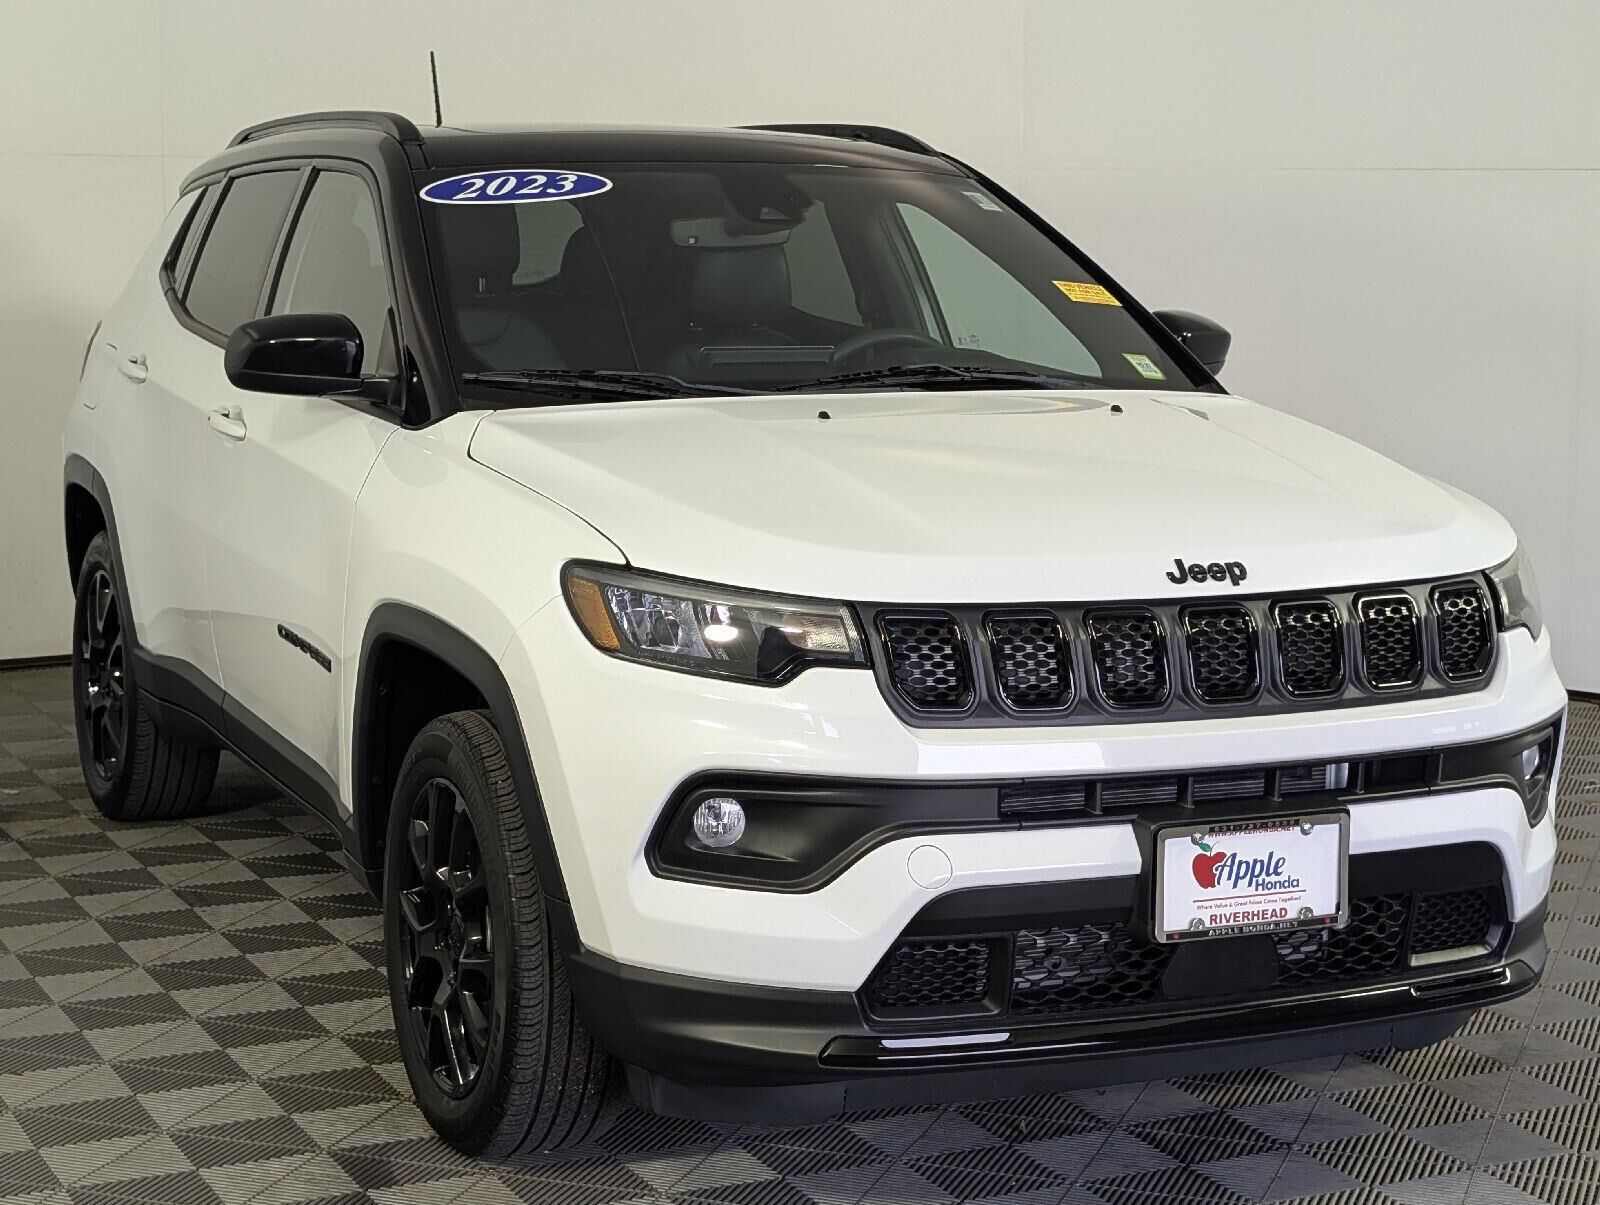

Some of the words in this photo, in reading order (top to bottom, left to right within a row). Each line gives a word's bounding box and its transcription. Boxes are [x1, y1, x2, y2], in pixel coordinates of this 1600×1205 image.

[452, 174, 578, 200] 2023
[1165, 558, 1248, 587] Jeep
[1214, 850, 1287, 890] Apple
[1254, 875, 1300, 892] Honda
[1196, 902, 1213, 910] Where
[1214, 901, 1228, 909] Value
[1209, 907, 1288, 926] RIVERHEAD
[1208, 926, 1240, 937] APPLE
